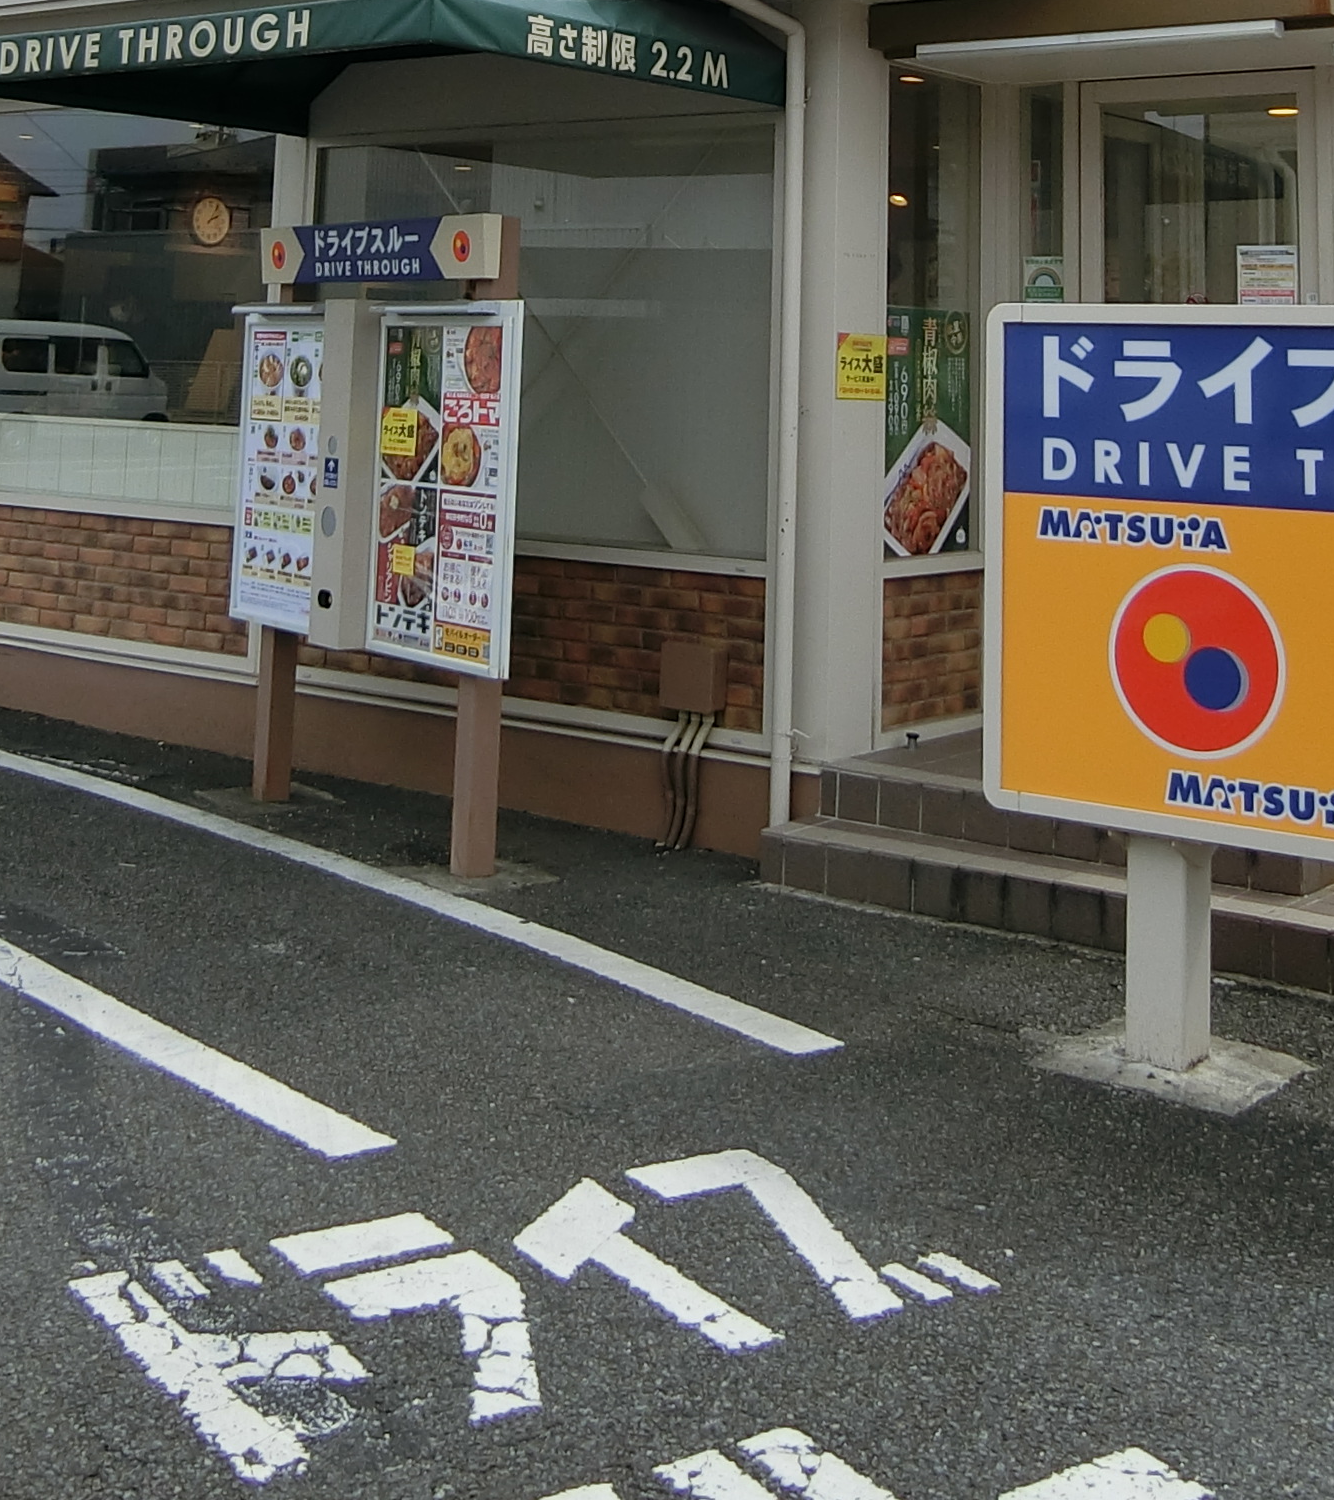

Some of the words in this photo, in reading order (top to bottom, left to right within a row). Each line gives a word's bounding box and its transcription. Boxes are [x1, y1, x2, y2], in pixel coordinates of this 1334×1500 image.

[0, 31, 101, 77] DRIVE
[118, 8, 311, 65] THROUGH
[526, 14, 636, 74] 高さ制限
[314, 225, 420, 257] ドライブスルー
[314, 260, 352, 277] DRIVE
[356, 257, 420, 276] THROUGH
[839, 354, 884, 374] ライス大盛
[1042, 437, 1252, 493] DRIVE
